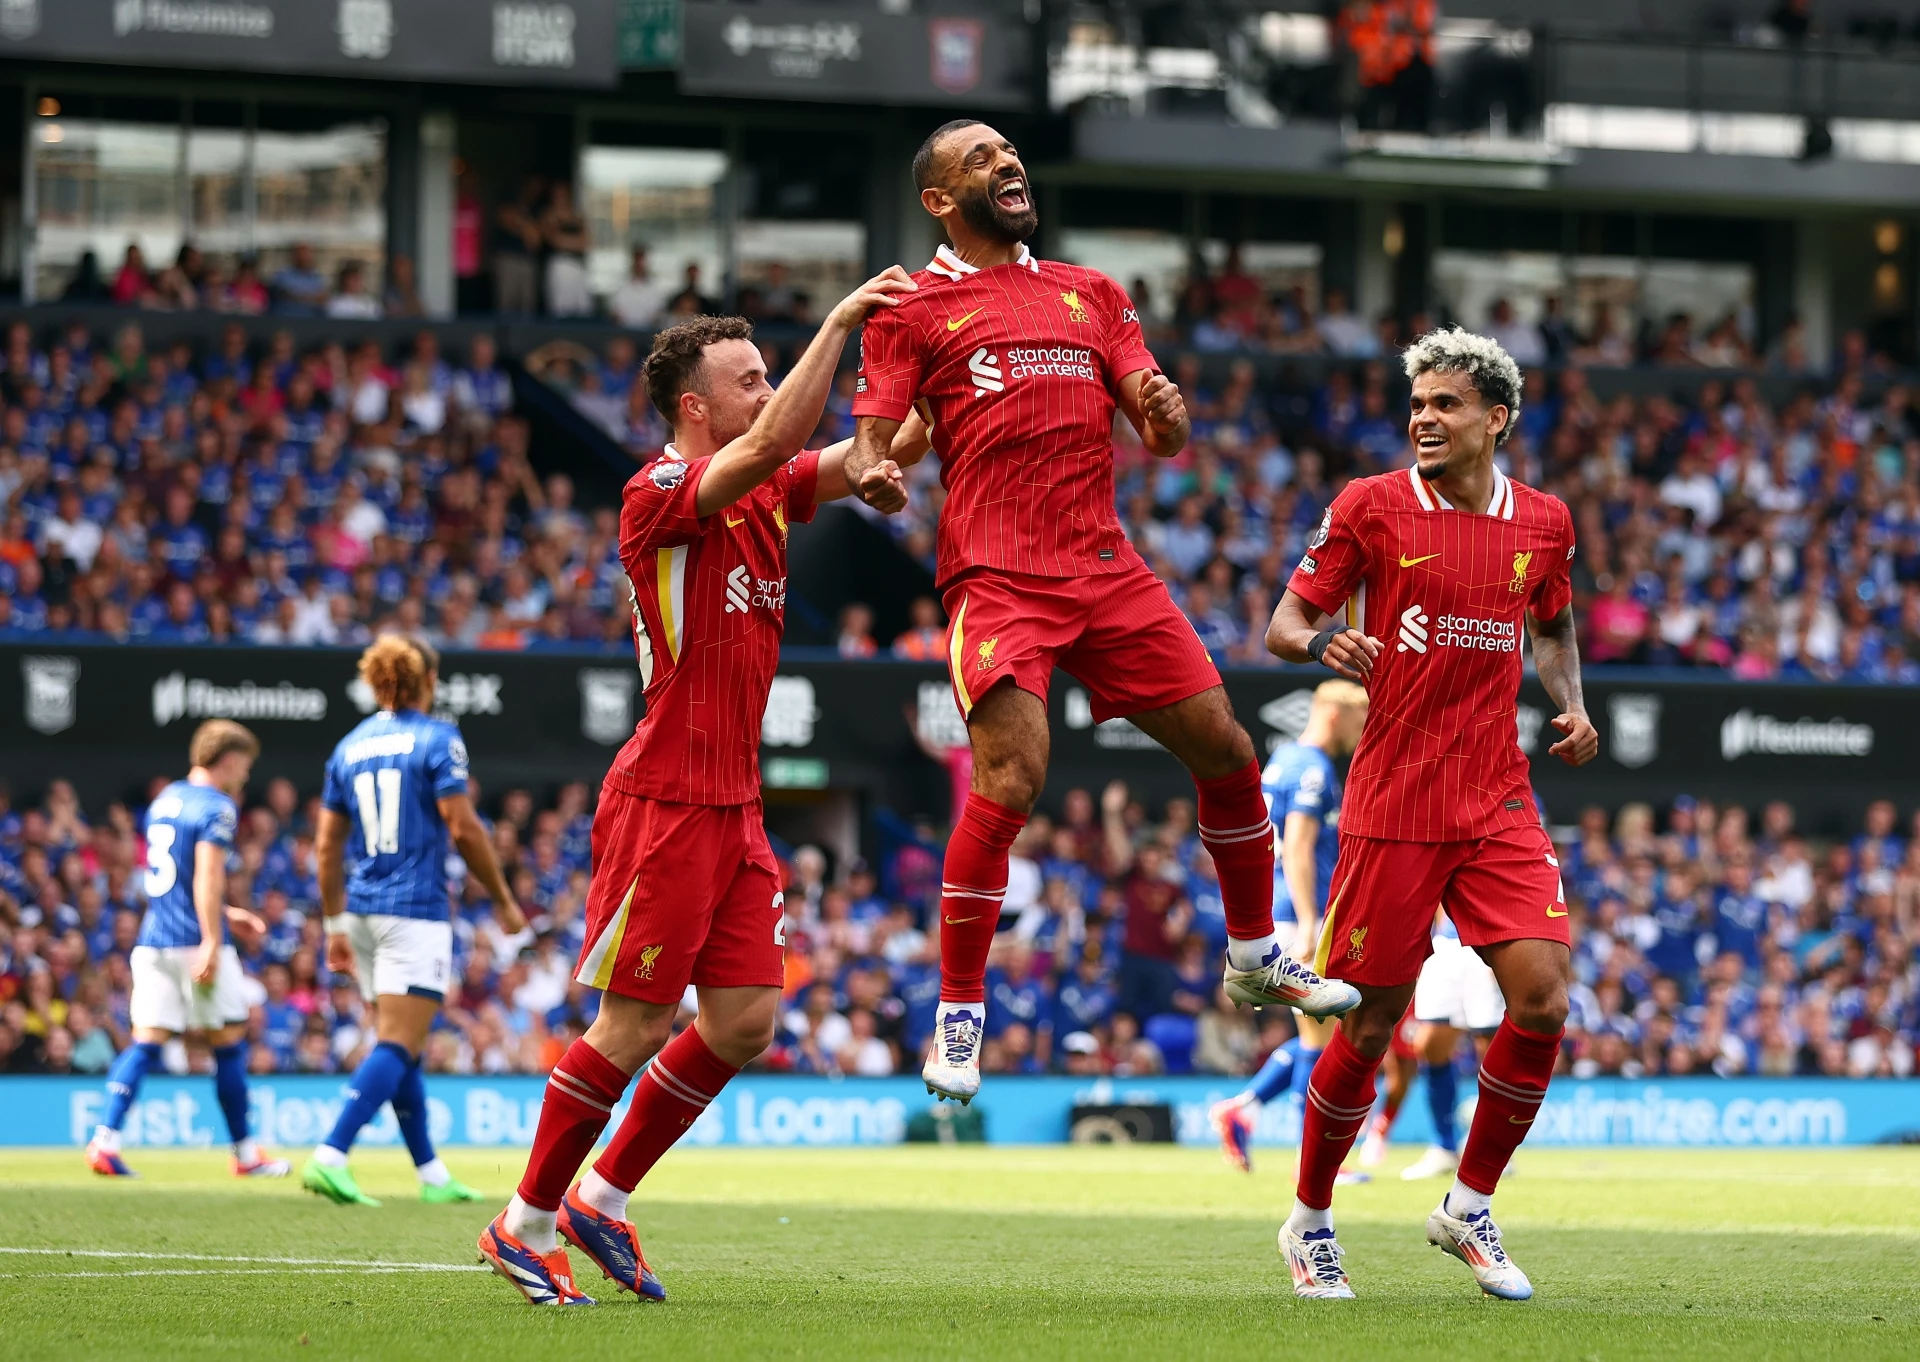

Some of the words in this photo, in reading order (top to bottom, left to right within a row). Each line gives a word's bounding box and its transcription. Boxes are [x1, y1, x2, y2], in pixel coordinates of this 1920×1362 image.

[1007, 345, 1092, 364] standard
[1011, 362, 1094, 381] chartered
[1437, 613, 1515, 636] standard
[1435, 630, 1516, 653] chartered
[353, 767, 402, 858] 11
[143, 823, 178, 898] 3
[737, 1091, 908, 1146] Loans
